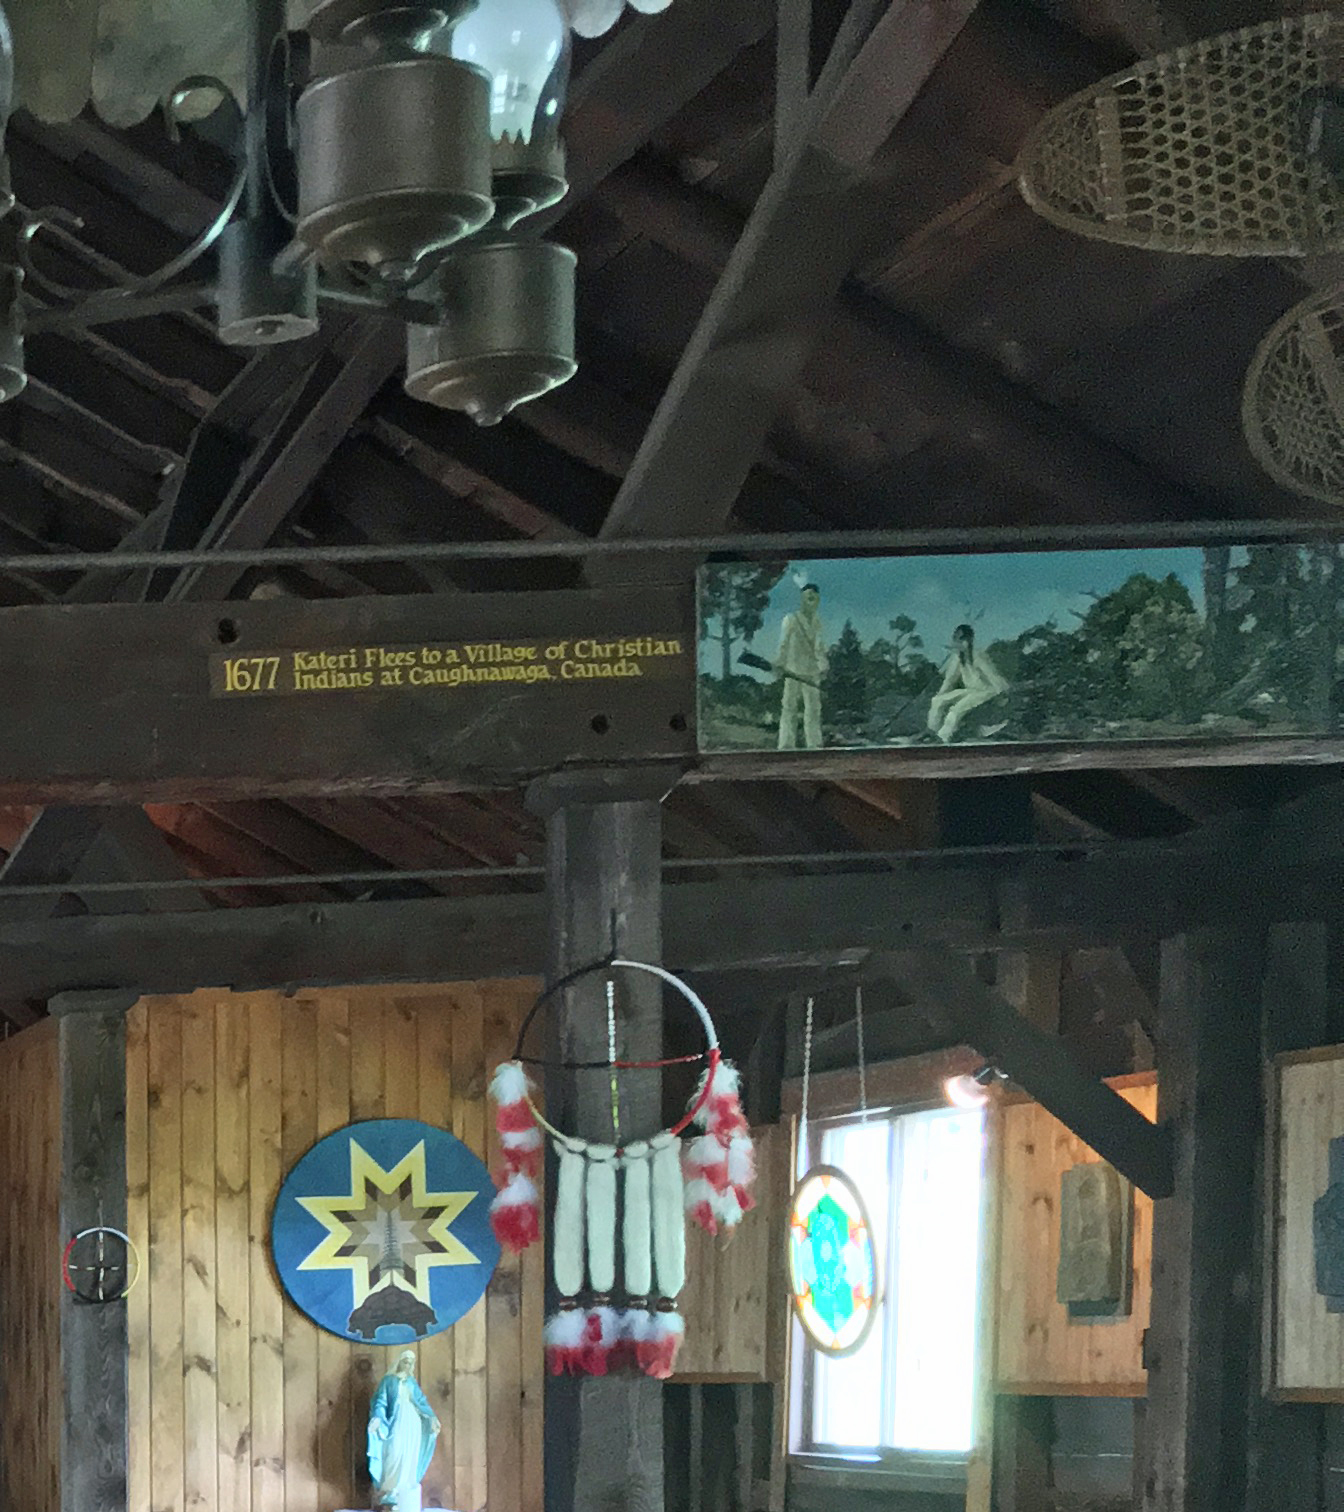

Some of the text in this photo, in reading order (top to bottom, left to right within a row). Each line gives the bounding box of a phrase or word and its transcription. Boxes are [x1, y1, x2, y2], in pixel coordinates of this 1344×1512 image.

[293, 636, 682, 670] Kateri Flees to a Village of Christian
[223, 657, 280, 691] 1677
[293, 669, 374, 690] Indians
[380, 667, 404, 686] at
[560, 658, 644, 679] Canada
